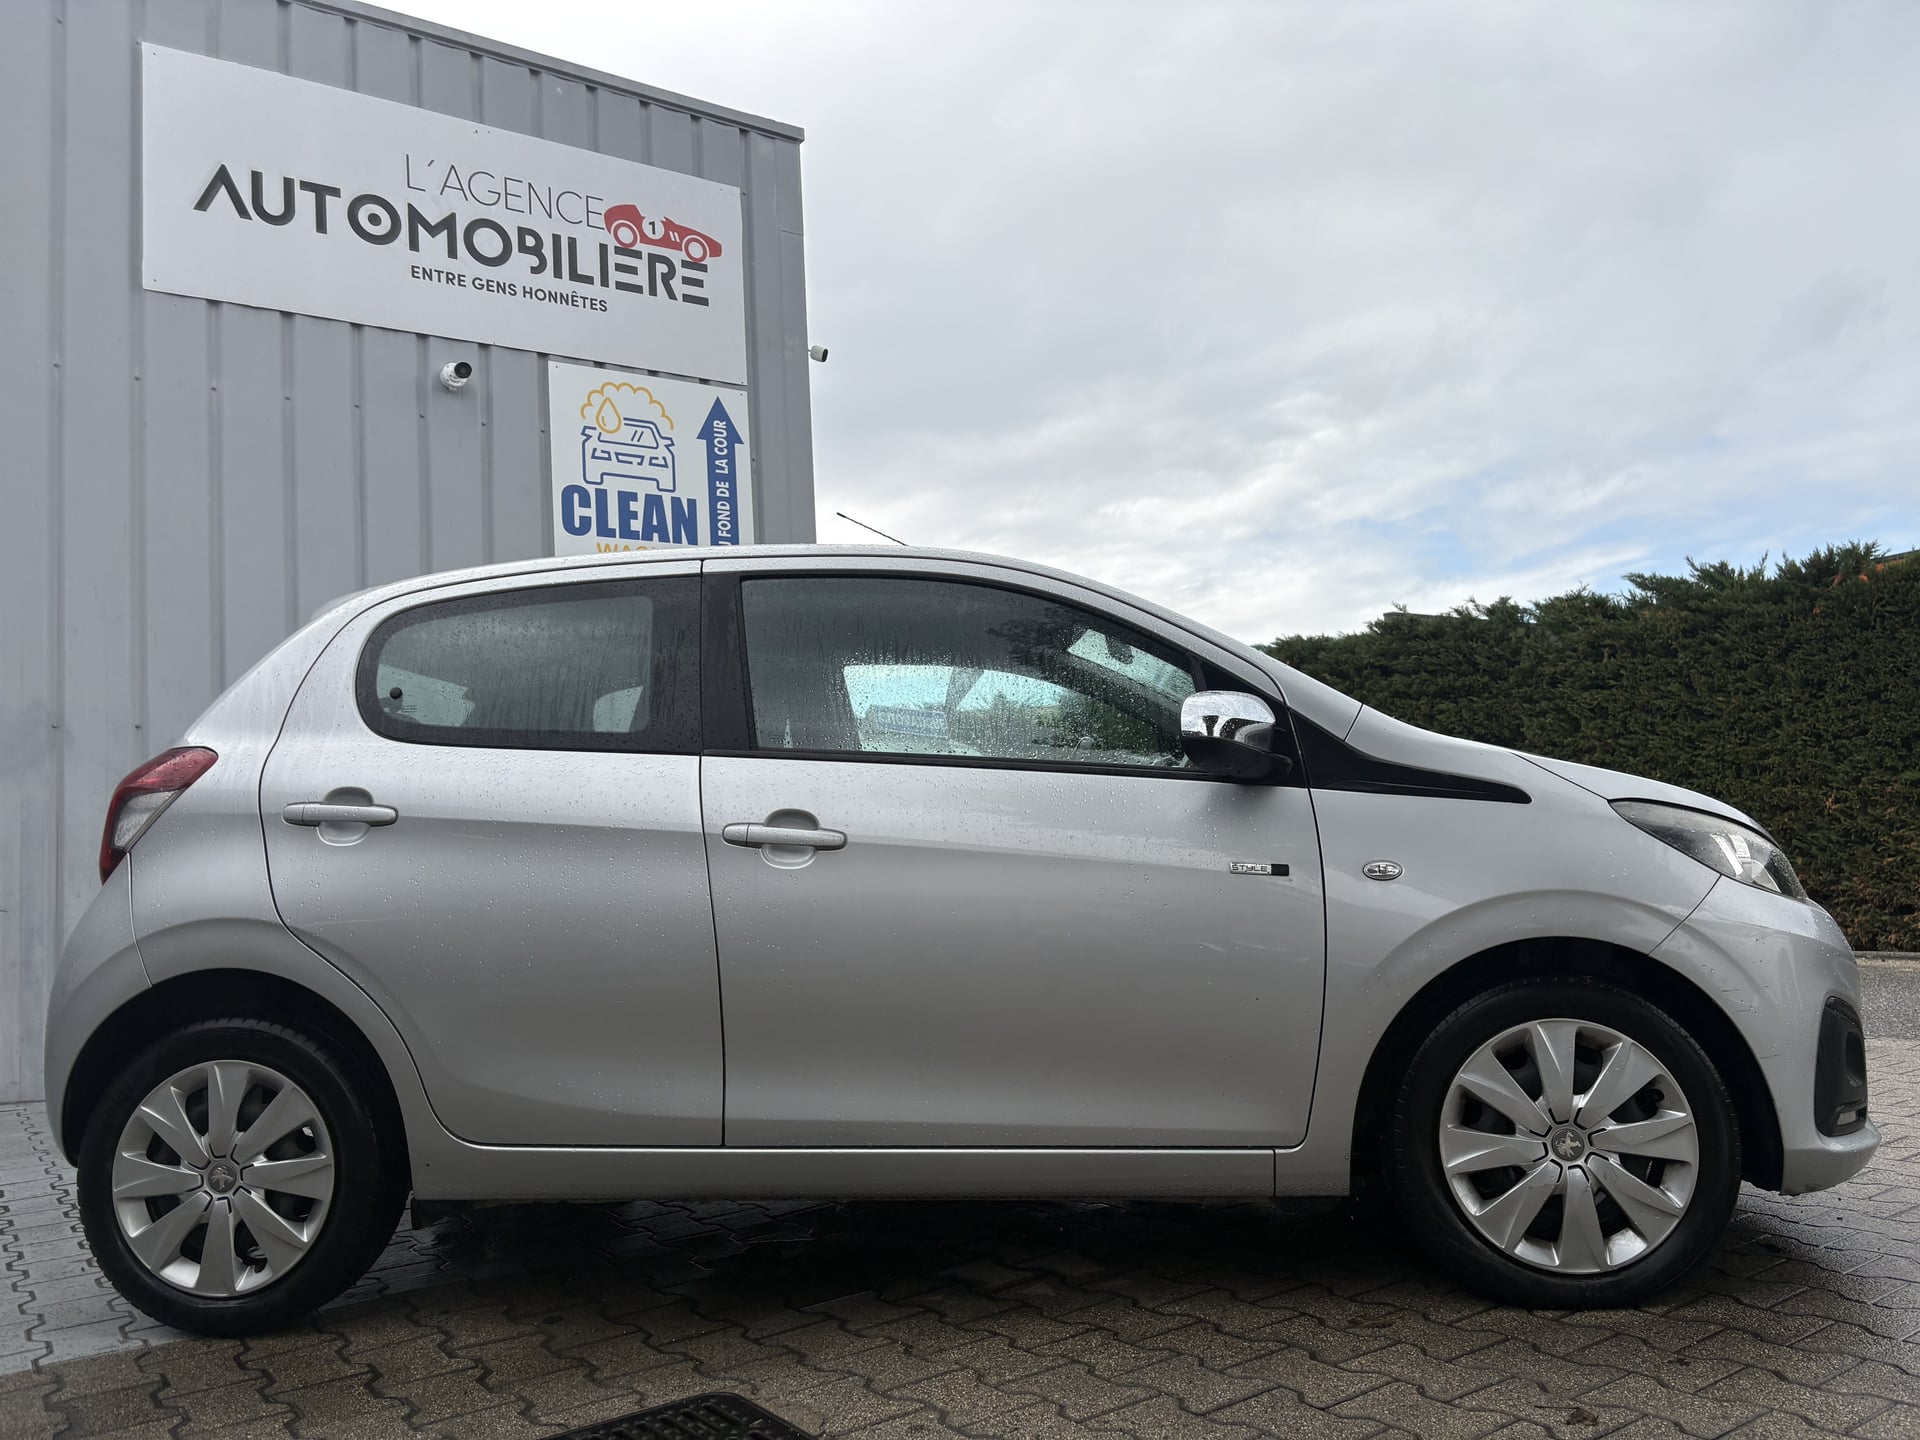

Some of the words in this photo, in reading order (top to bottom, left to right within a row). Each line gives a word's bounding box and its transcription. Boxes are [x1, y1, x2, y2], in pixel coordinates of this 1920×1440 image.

[193, 163, 710, 307] AUTOMOBILIERE
[648, 220, 656, 235] 1
[410, 264, 467, 288] ENTRE
[471, 276, 518, 297] GENS
[522, 285, 608, 312] HONNÊTES
[713, 420, 728, 455] COUR
[714, 459, 729, 475] LA
[715, 480, 730, 498] DE
[561, 484, 699, 546] CLEAN
[716, 500, 731, 537] FOND
[1231, 863, 1268, 873] STYLE
